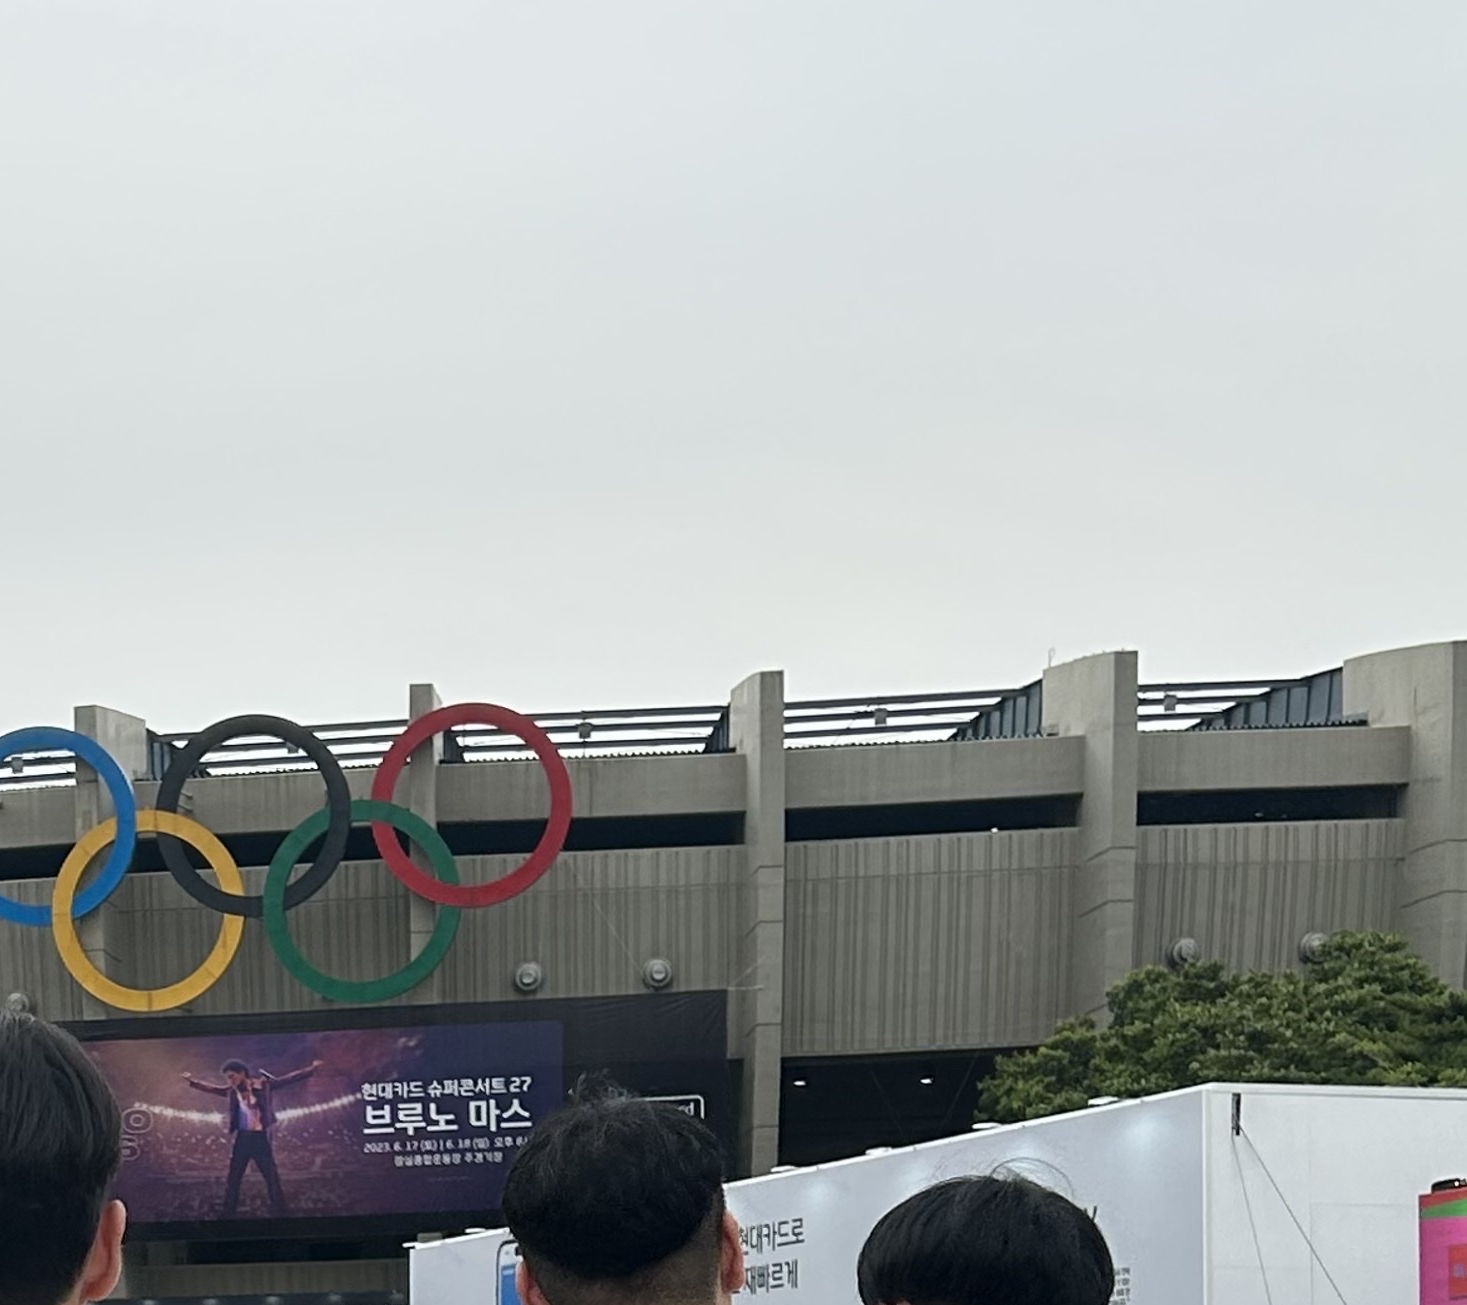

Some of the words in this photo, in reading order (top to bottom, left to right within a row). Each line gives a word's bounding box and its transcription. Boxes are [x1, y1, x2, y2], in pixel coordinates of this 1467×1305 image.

[361, 1082, 425, 1101] 현대카드
[427, 1077, 507, 1098] 슈퍼콘서트
[509, 1076, 532, 1093] 27
[363, 1102, 459, 1136] 브루노
[469, 1098, 532, 1132] 마스
